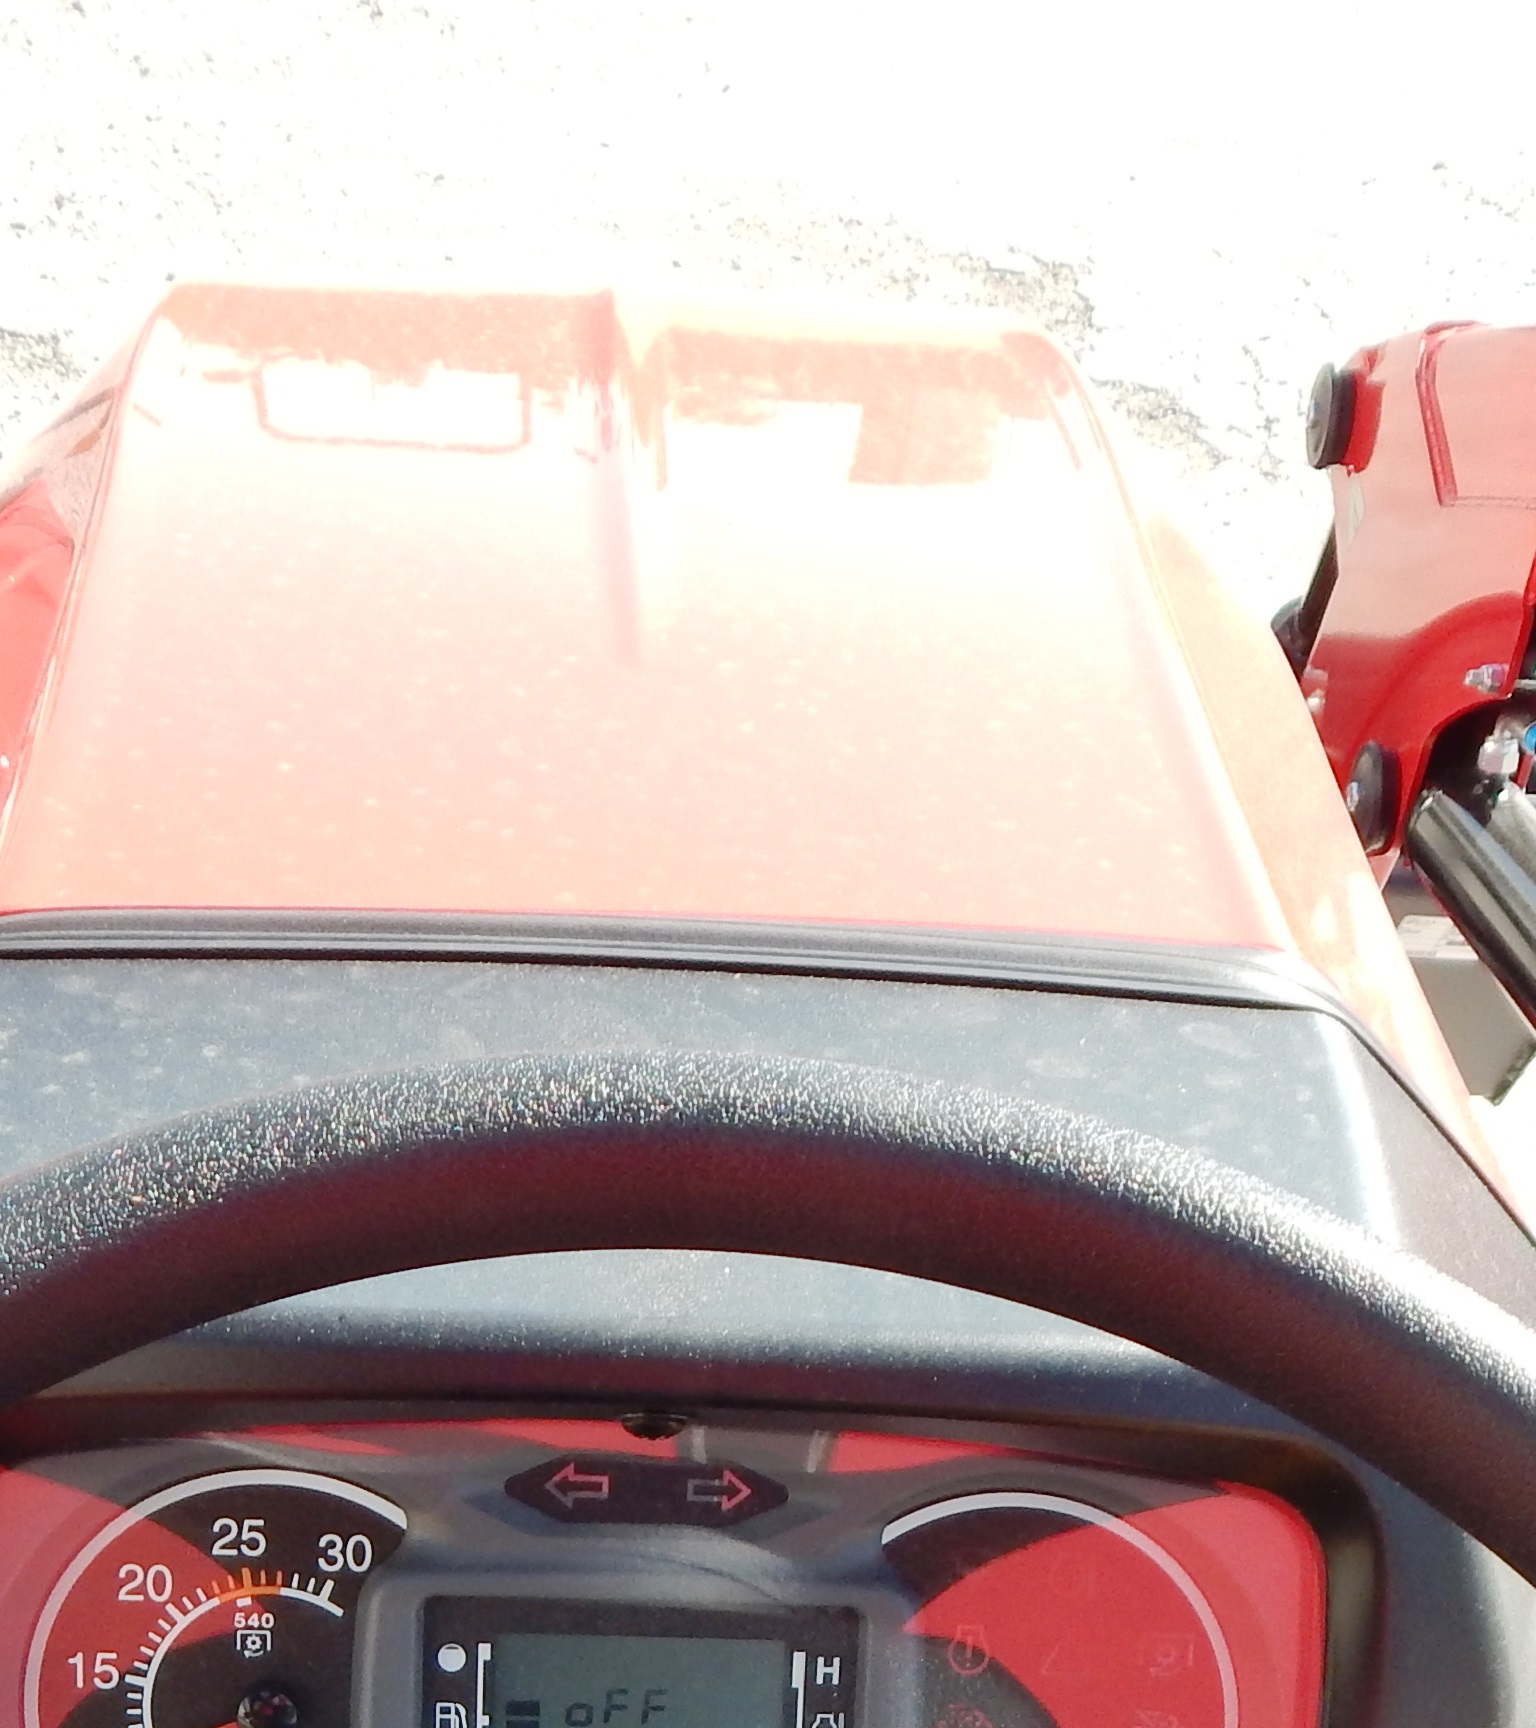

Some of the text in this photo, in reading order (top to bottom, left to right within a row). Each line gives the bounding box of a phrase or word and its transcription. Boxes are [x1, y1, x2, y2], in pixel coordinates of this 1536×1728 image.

[211, 1518, 266, 1557] 25
[317, 1535, 372, 1573] 30
[118, 1564, 173, 1603] 20
[233, 1612, 275, 1628] 540
[68, 1653, 120, 1690] 15
[816, 1656, 840, 1685] H
